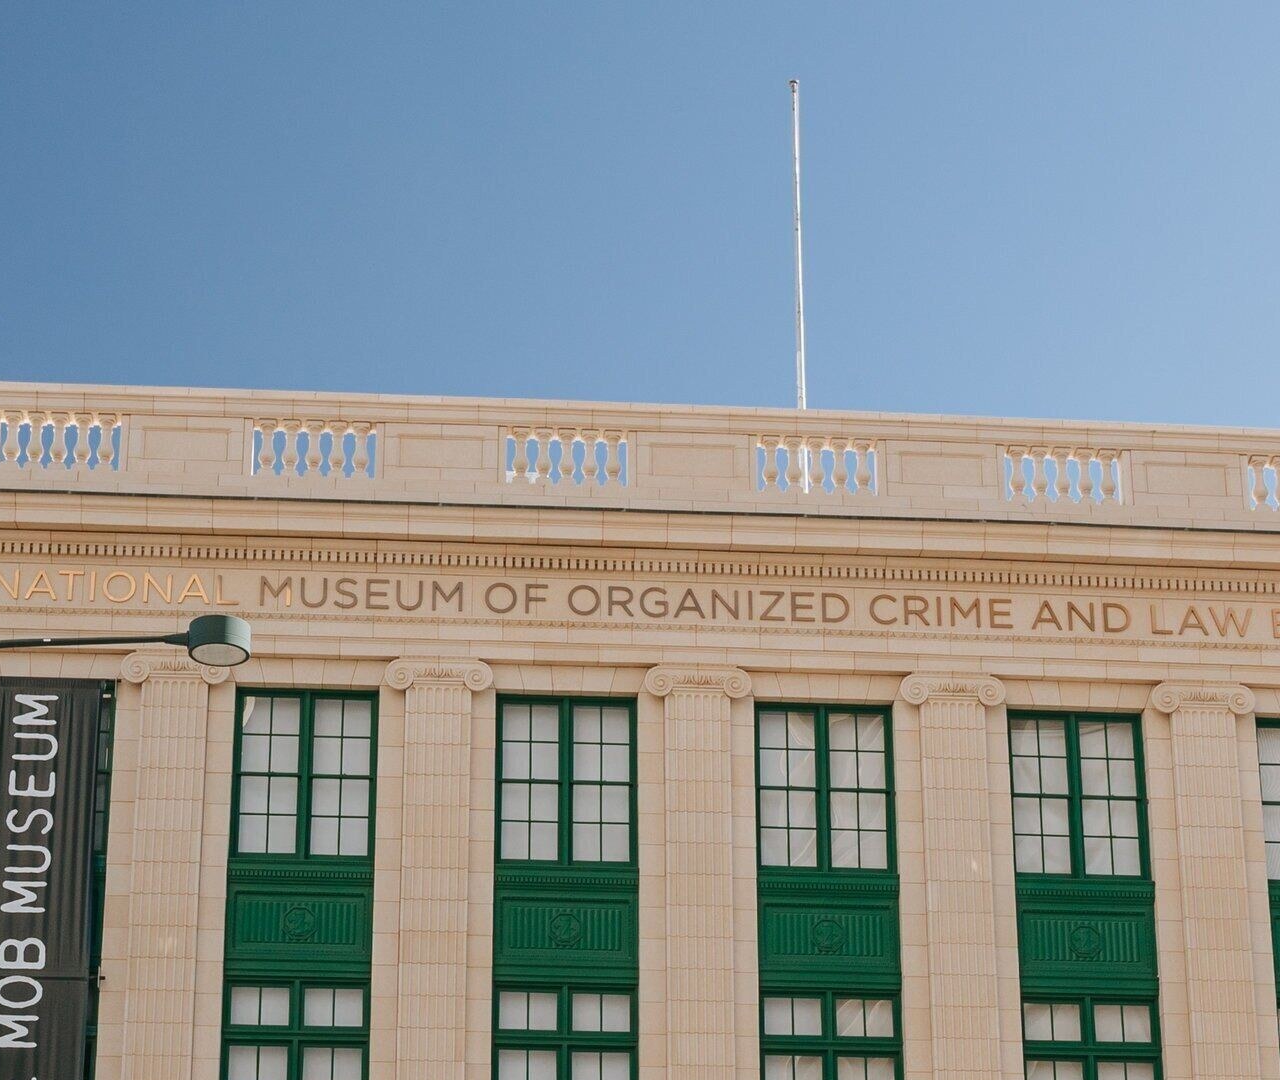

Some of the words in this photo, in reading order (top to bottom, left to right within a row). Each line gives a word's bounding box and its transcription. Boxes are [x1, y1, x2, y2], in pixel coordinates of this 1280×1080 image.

[259, 575, 463, 612] MUSEUM
[484, 582, 549, 614] OF
[568, 584, 850, 623] ORGANIZED
[869, 594, 1013, 629] CRIME
[1031, 599, 1131, 633] AND
[1150, 603, 1253, 637] LAW
[0, 693, 59, 914] MUSEUM
